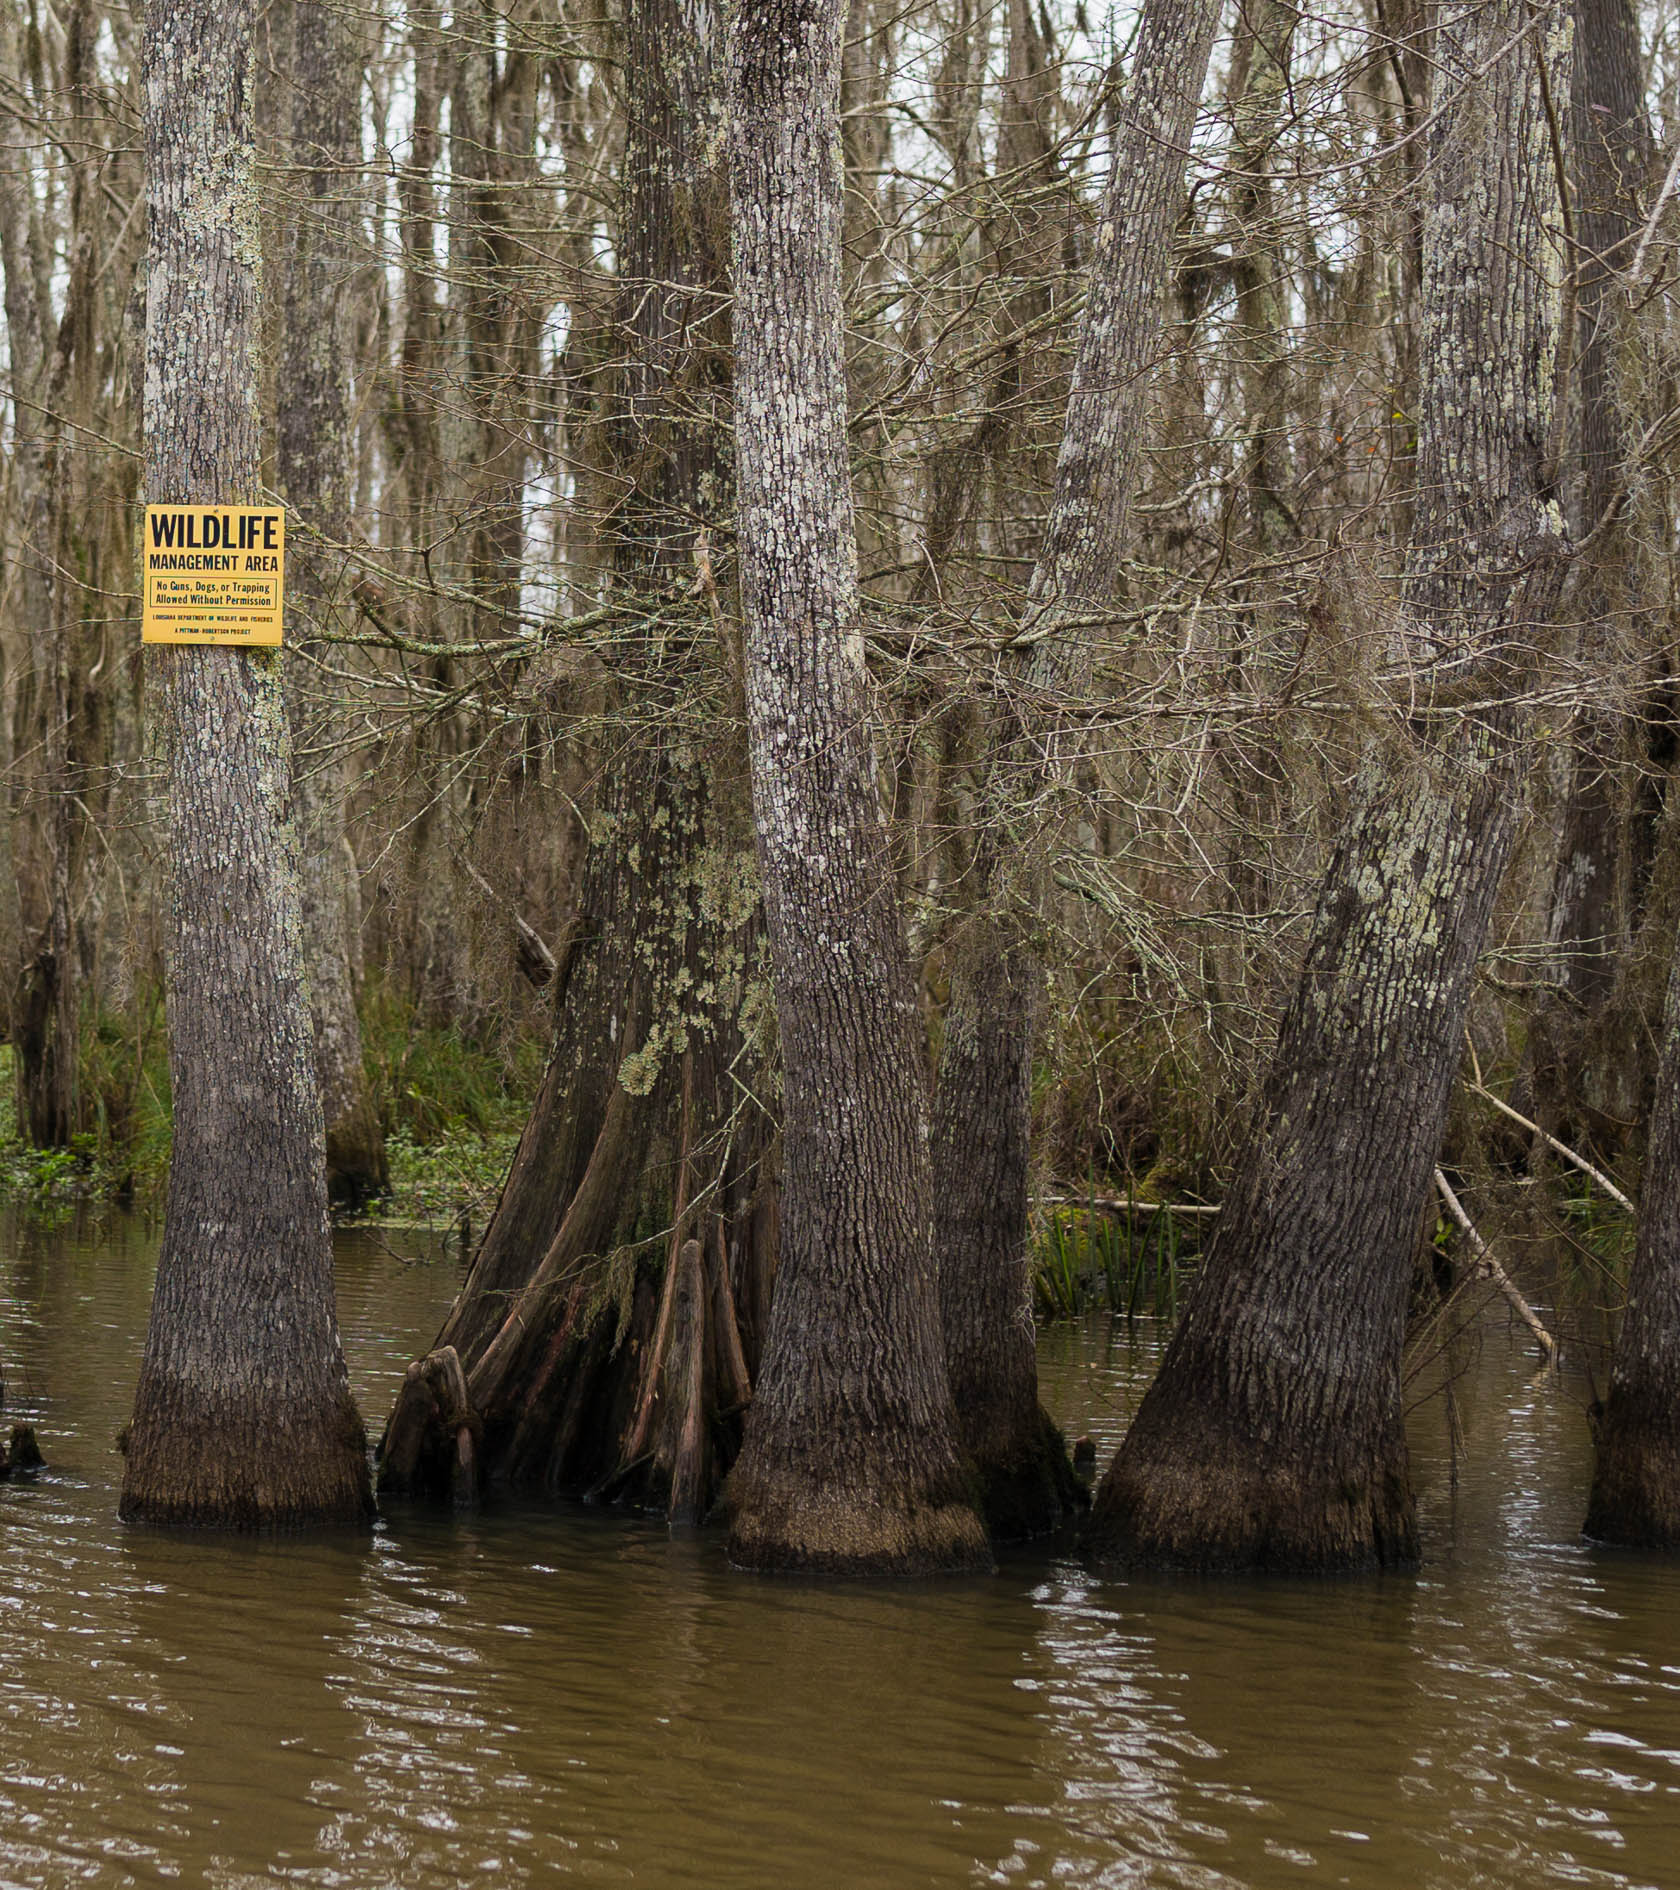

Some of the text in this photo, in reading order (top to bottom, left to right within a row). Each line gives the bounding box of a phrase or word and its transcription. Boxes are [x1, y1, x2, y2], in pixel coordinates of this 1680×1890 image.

[151, 514, 278, 550] WILDLIFE
[150, 554, 278, 571] MANAGEMENT AREA
[157, 581, 269, 594] No Guns, Dogs, or Trapping
[156, 595, 271, 606] Allowed Without Permission
